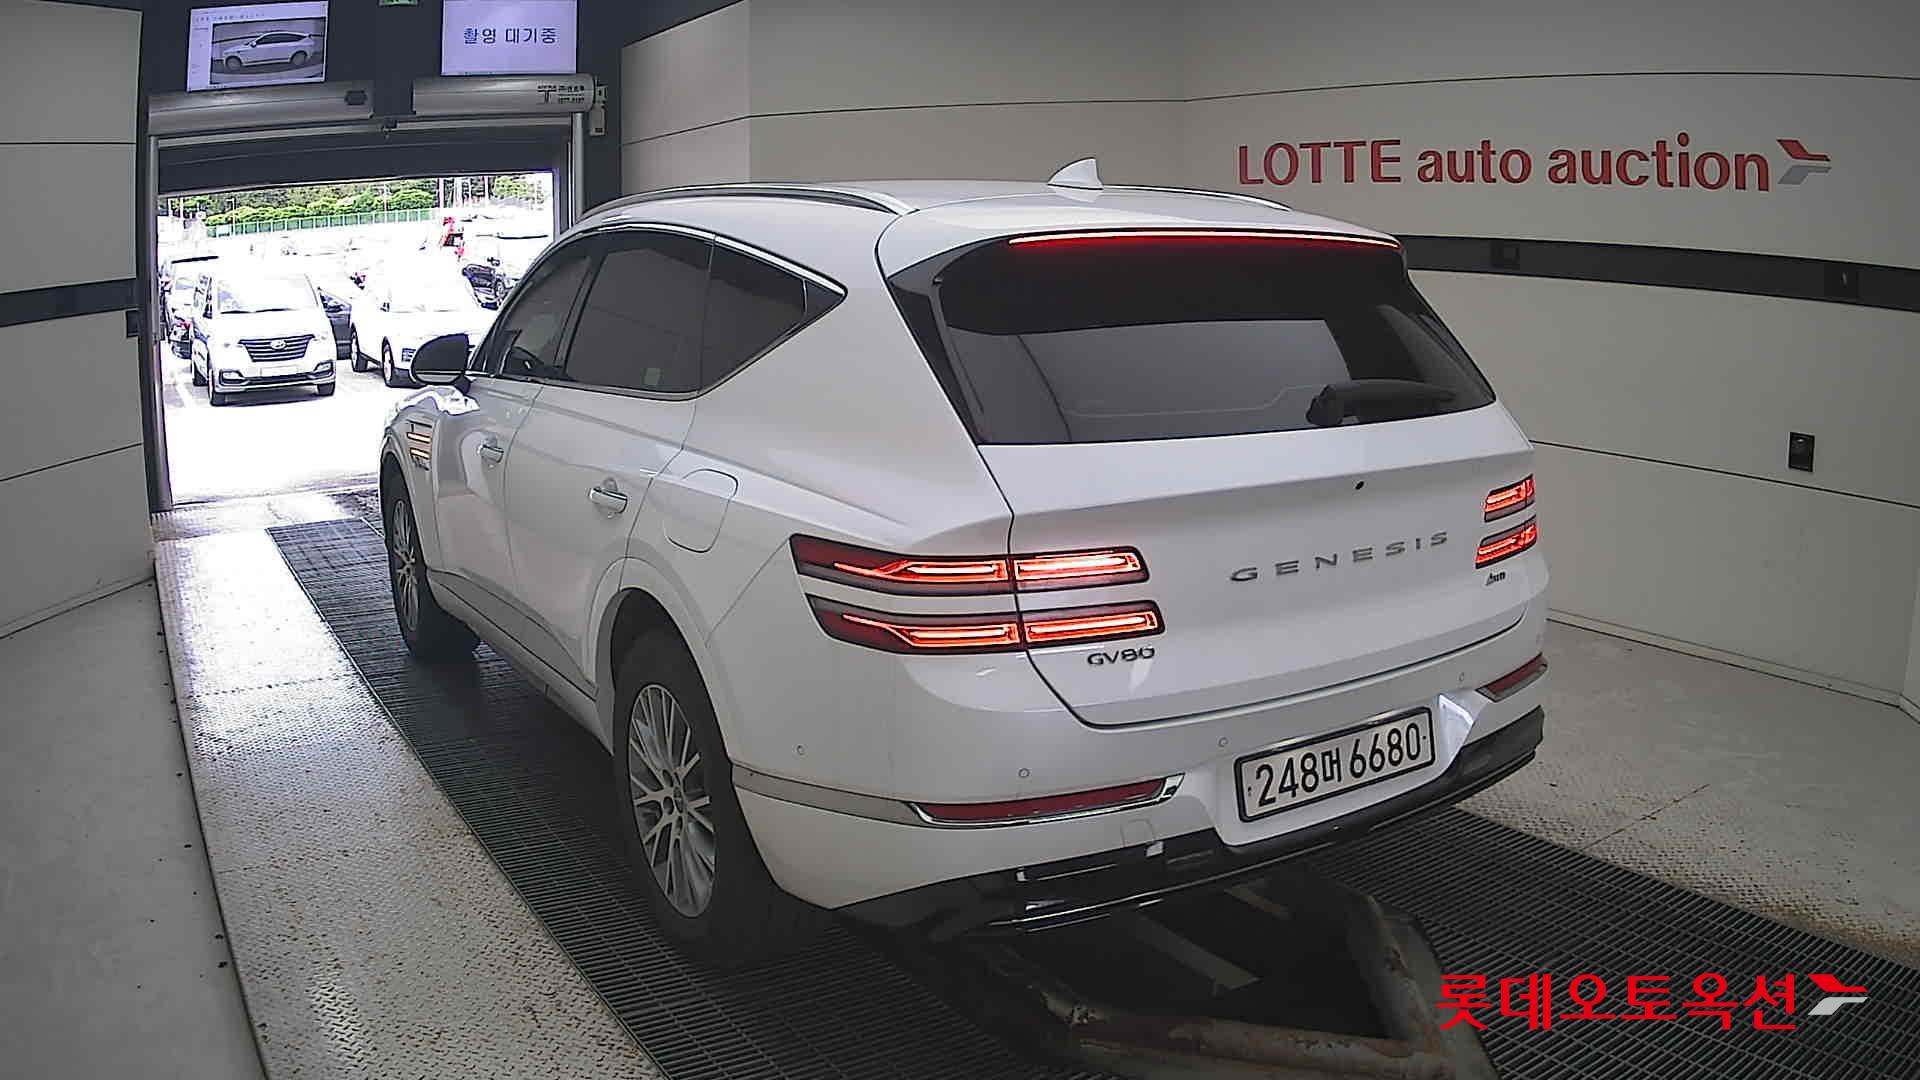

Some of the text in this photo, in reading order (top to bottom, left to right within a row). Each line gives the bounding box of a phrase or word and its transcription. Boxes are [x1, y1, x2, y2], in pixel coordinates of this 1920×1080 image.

[463, 27, 558, 45] 촬영 대기중
[1238, 132, 1770, 192] LOTTE auto auction
[1229, 531, 1448, 582] GENESIS
[1087, 647, 1156, 666] GV80
[1255, 722, 1422, 808] 248머 6680
